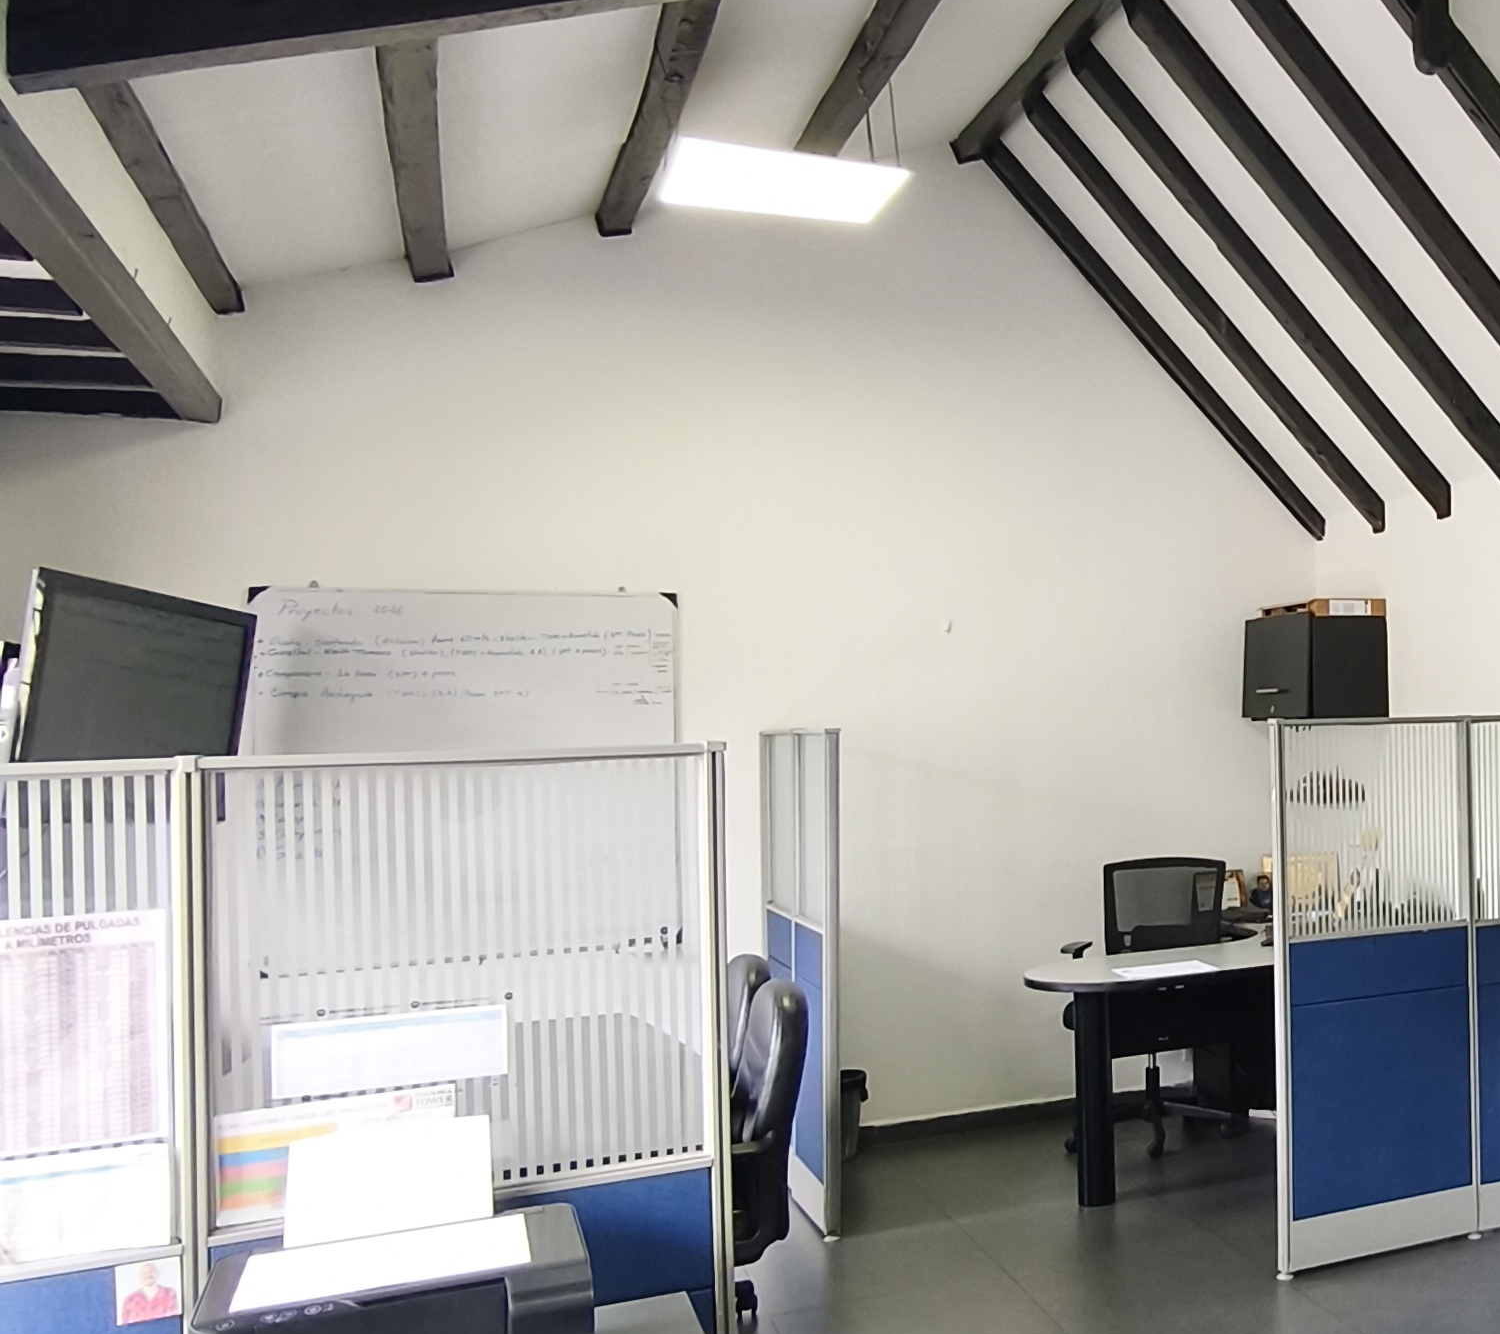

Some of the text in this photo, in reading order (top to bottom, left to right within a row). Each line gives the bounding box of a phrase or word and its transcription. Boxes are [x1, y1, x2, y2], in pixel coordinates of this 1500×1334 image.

[54, 921, 71, 934] DE
[74, 916, 141, 931] PULGADAS
[4, 940, 13, 950] A
